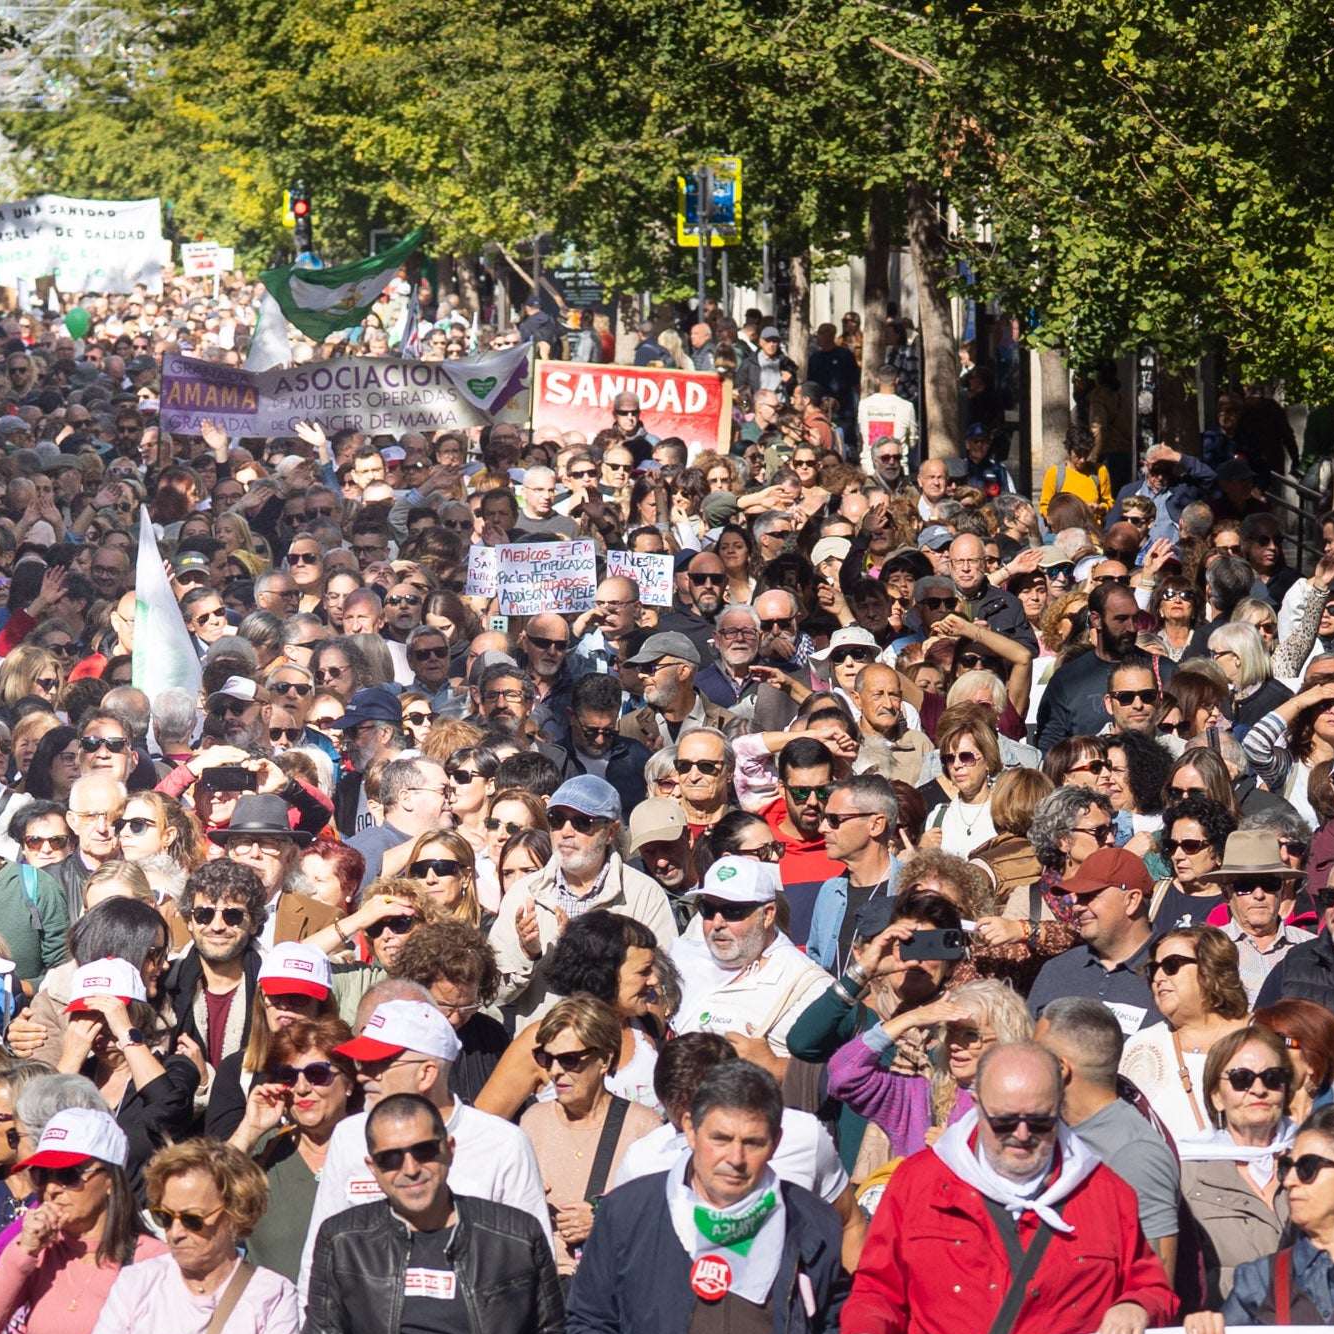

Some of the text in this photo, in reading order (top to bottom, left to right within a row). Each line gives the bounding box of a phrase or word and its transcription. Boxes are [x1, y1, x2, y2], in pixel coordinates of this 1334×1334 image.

[13, 204, 42, 219] UNA
[49, 204, 116, 217] SANIDAD
[55, 226, 74, 237] DE
[85, 229, 145, 240] CALIDAD
[170, 360, 251, 385] GRANADA
[168, 380, 256, 410] AMAMA
[288, 393, 362, 410] MUJERES
[367, 387, 458, 409] OPERADAS
[271, 420, 285, 431] DE
[370, 413, 392, 429] DE
[398, 410, 458, 428] MAMA
[698, 1258, 729, 1283] UGT
